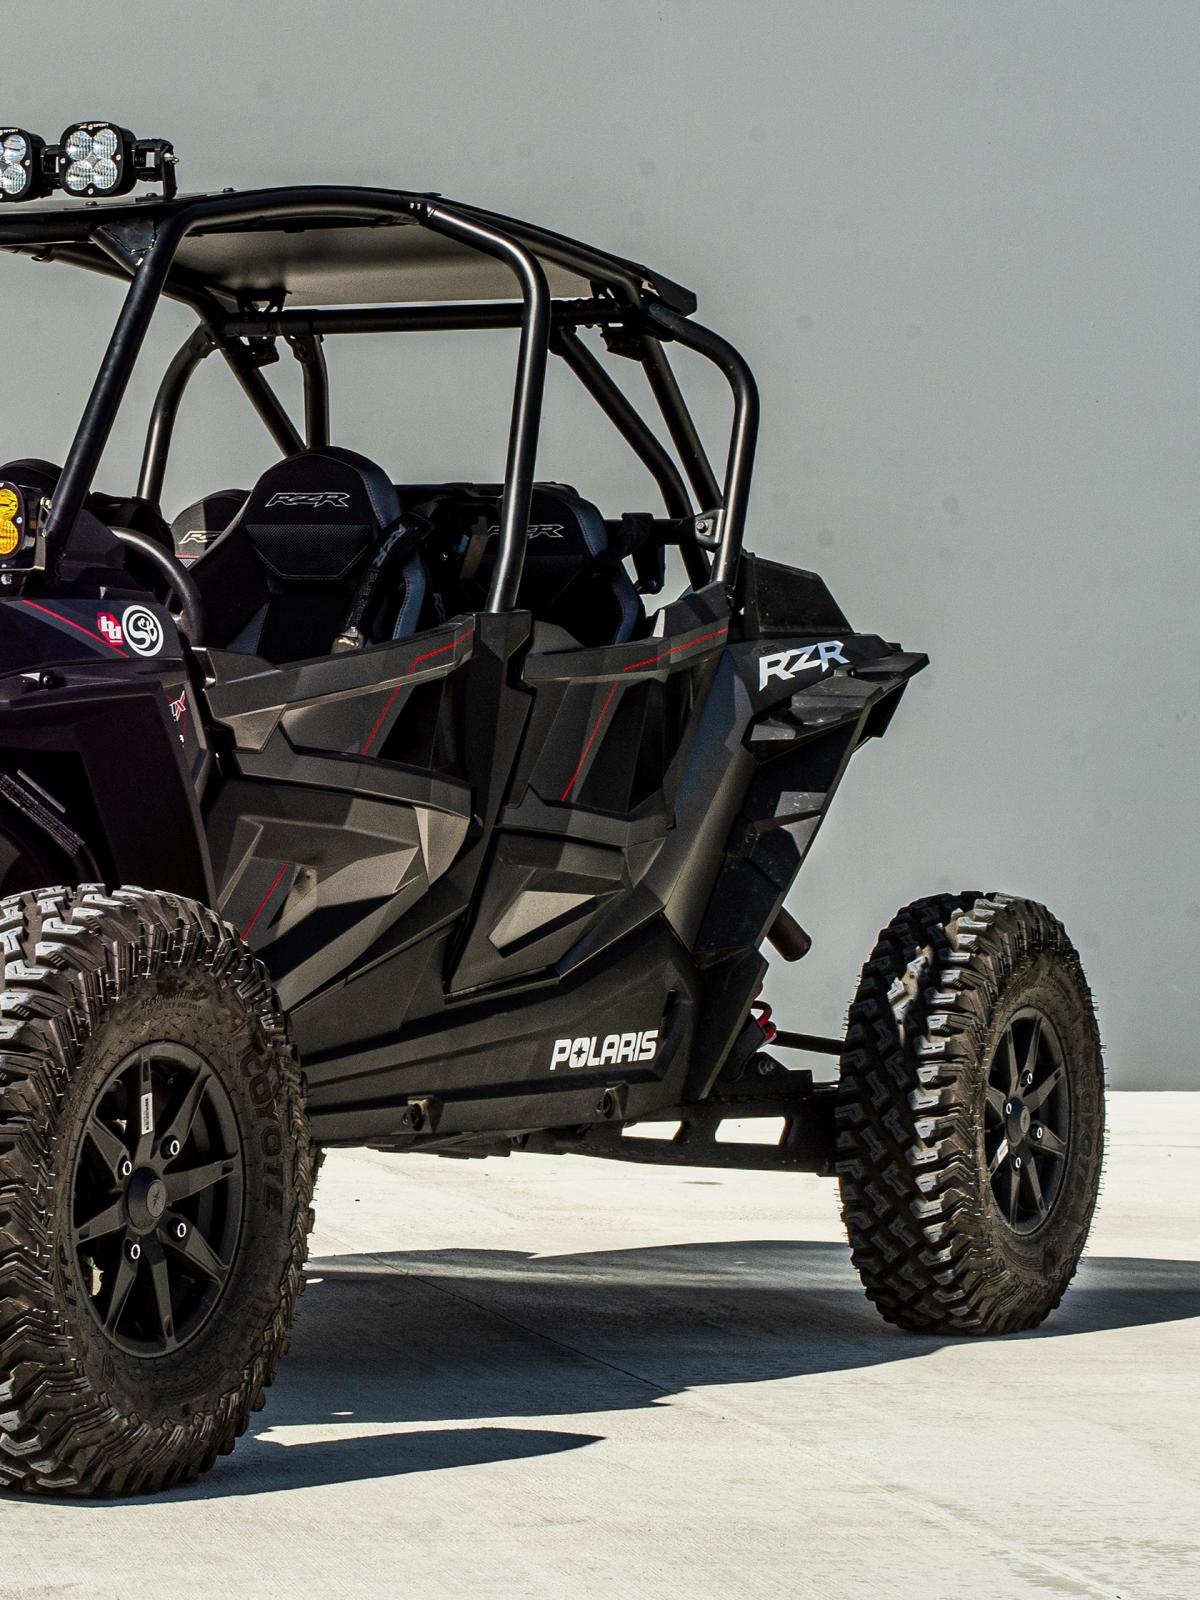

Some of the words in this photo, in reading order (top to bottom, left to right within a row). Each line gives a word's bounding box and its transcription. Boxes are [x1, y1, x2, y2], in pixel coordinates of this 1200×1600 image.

[265, 491, 349, 509] RZR
[758, 639, 850, 692] RZR
[549, 1029, 659, 1071] POLARIS
